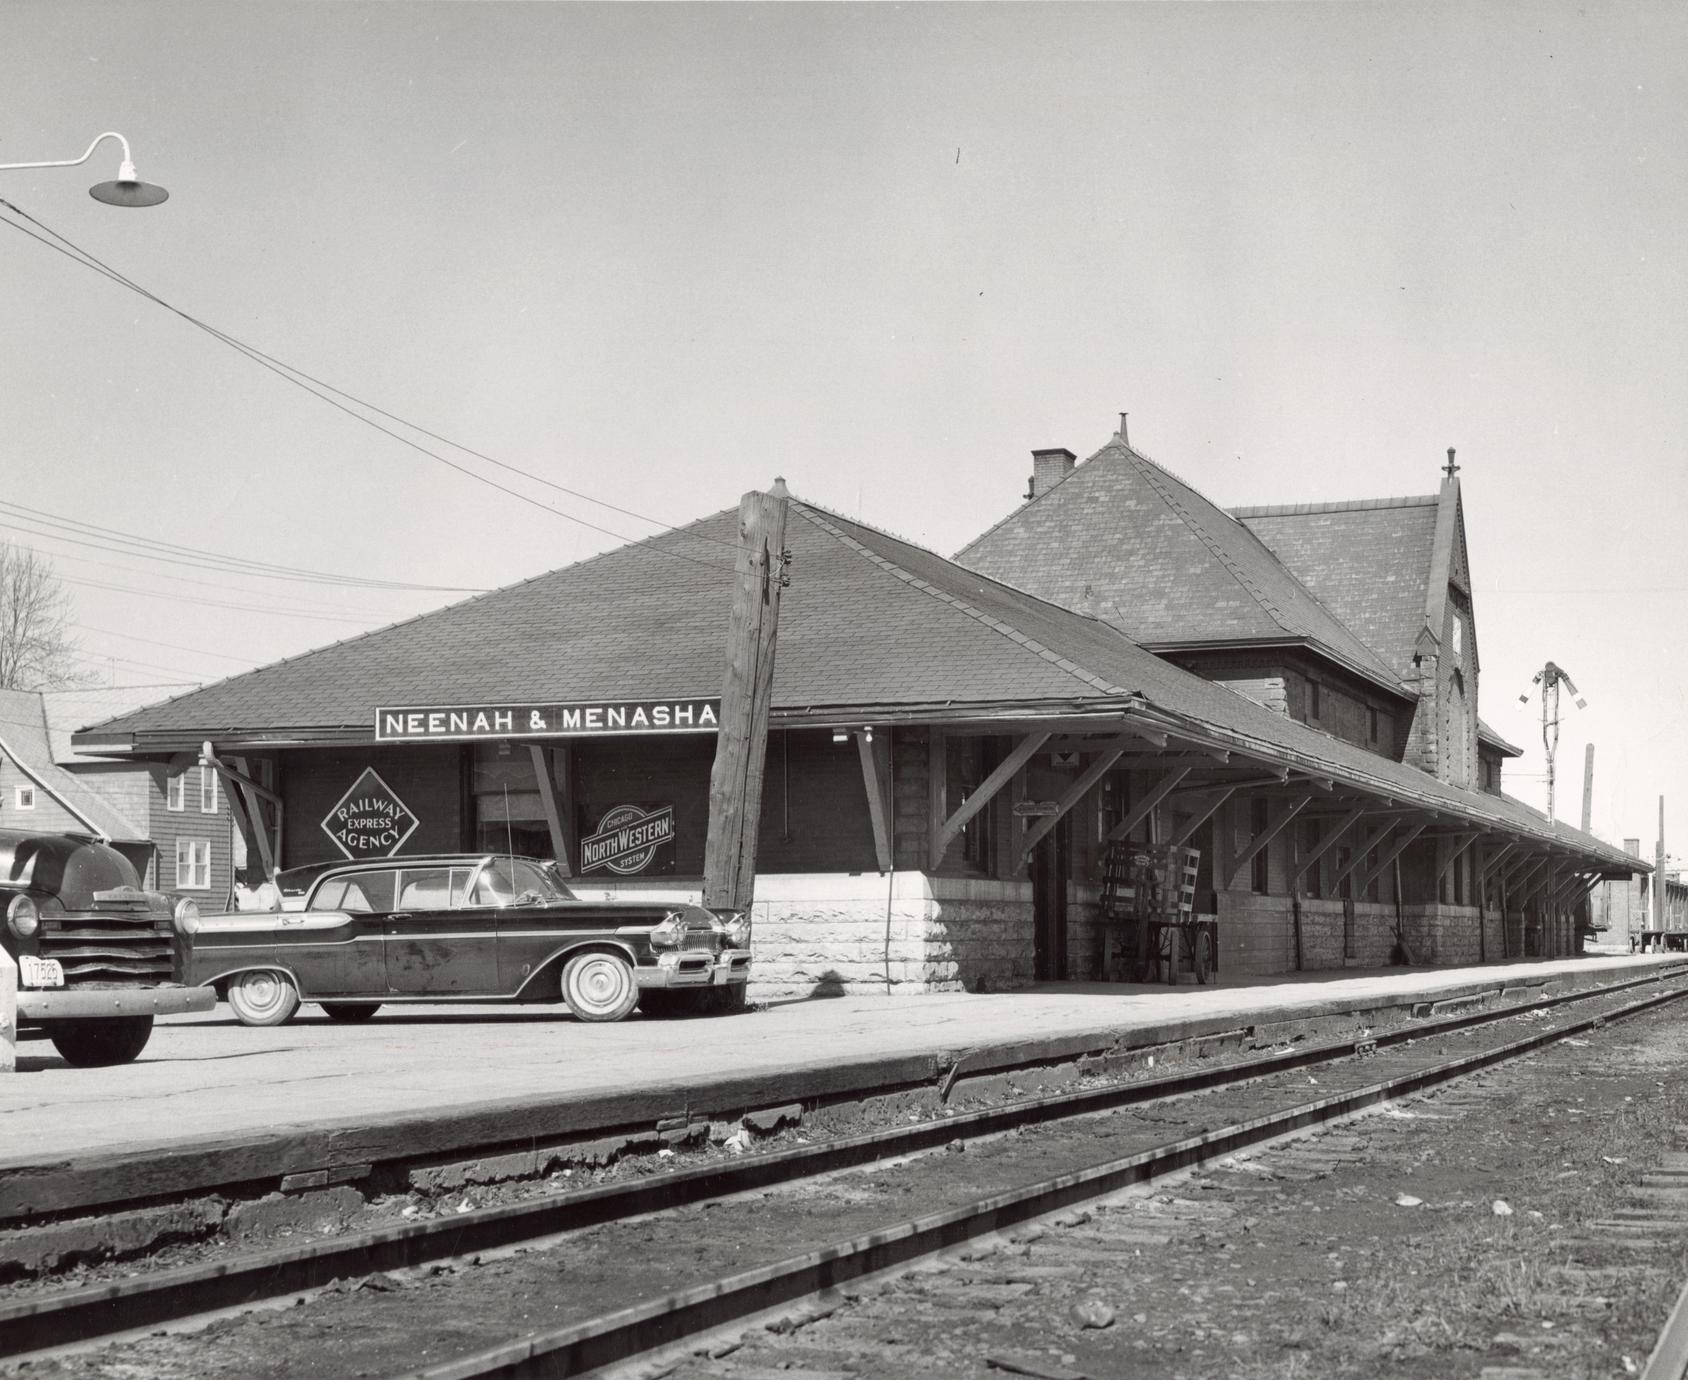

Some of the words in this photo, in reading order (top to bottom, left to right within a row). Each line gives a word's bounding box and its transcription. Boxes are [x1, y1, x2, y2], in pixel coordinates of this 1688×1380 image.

[386, 710, 512, 733] NEENAH
[529, 710, 547, 729] &
[562, 704, 718, 728] MENASHA
[337, 798, 405, 821] RAILWAY
[348, 818, 392, 829] EXPRESS
[607, 812, 633, 828] CHICAGO
[336, 825, 399, 849] AGENCY
[620, 852, 645, 868] SYSTEM
